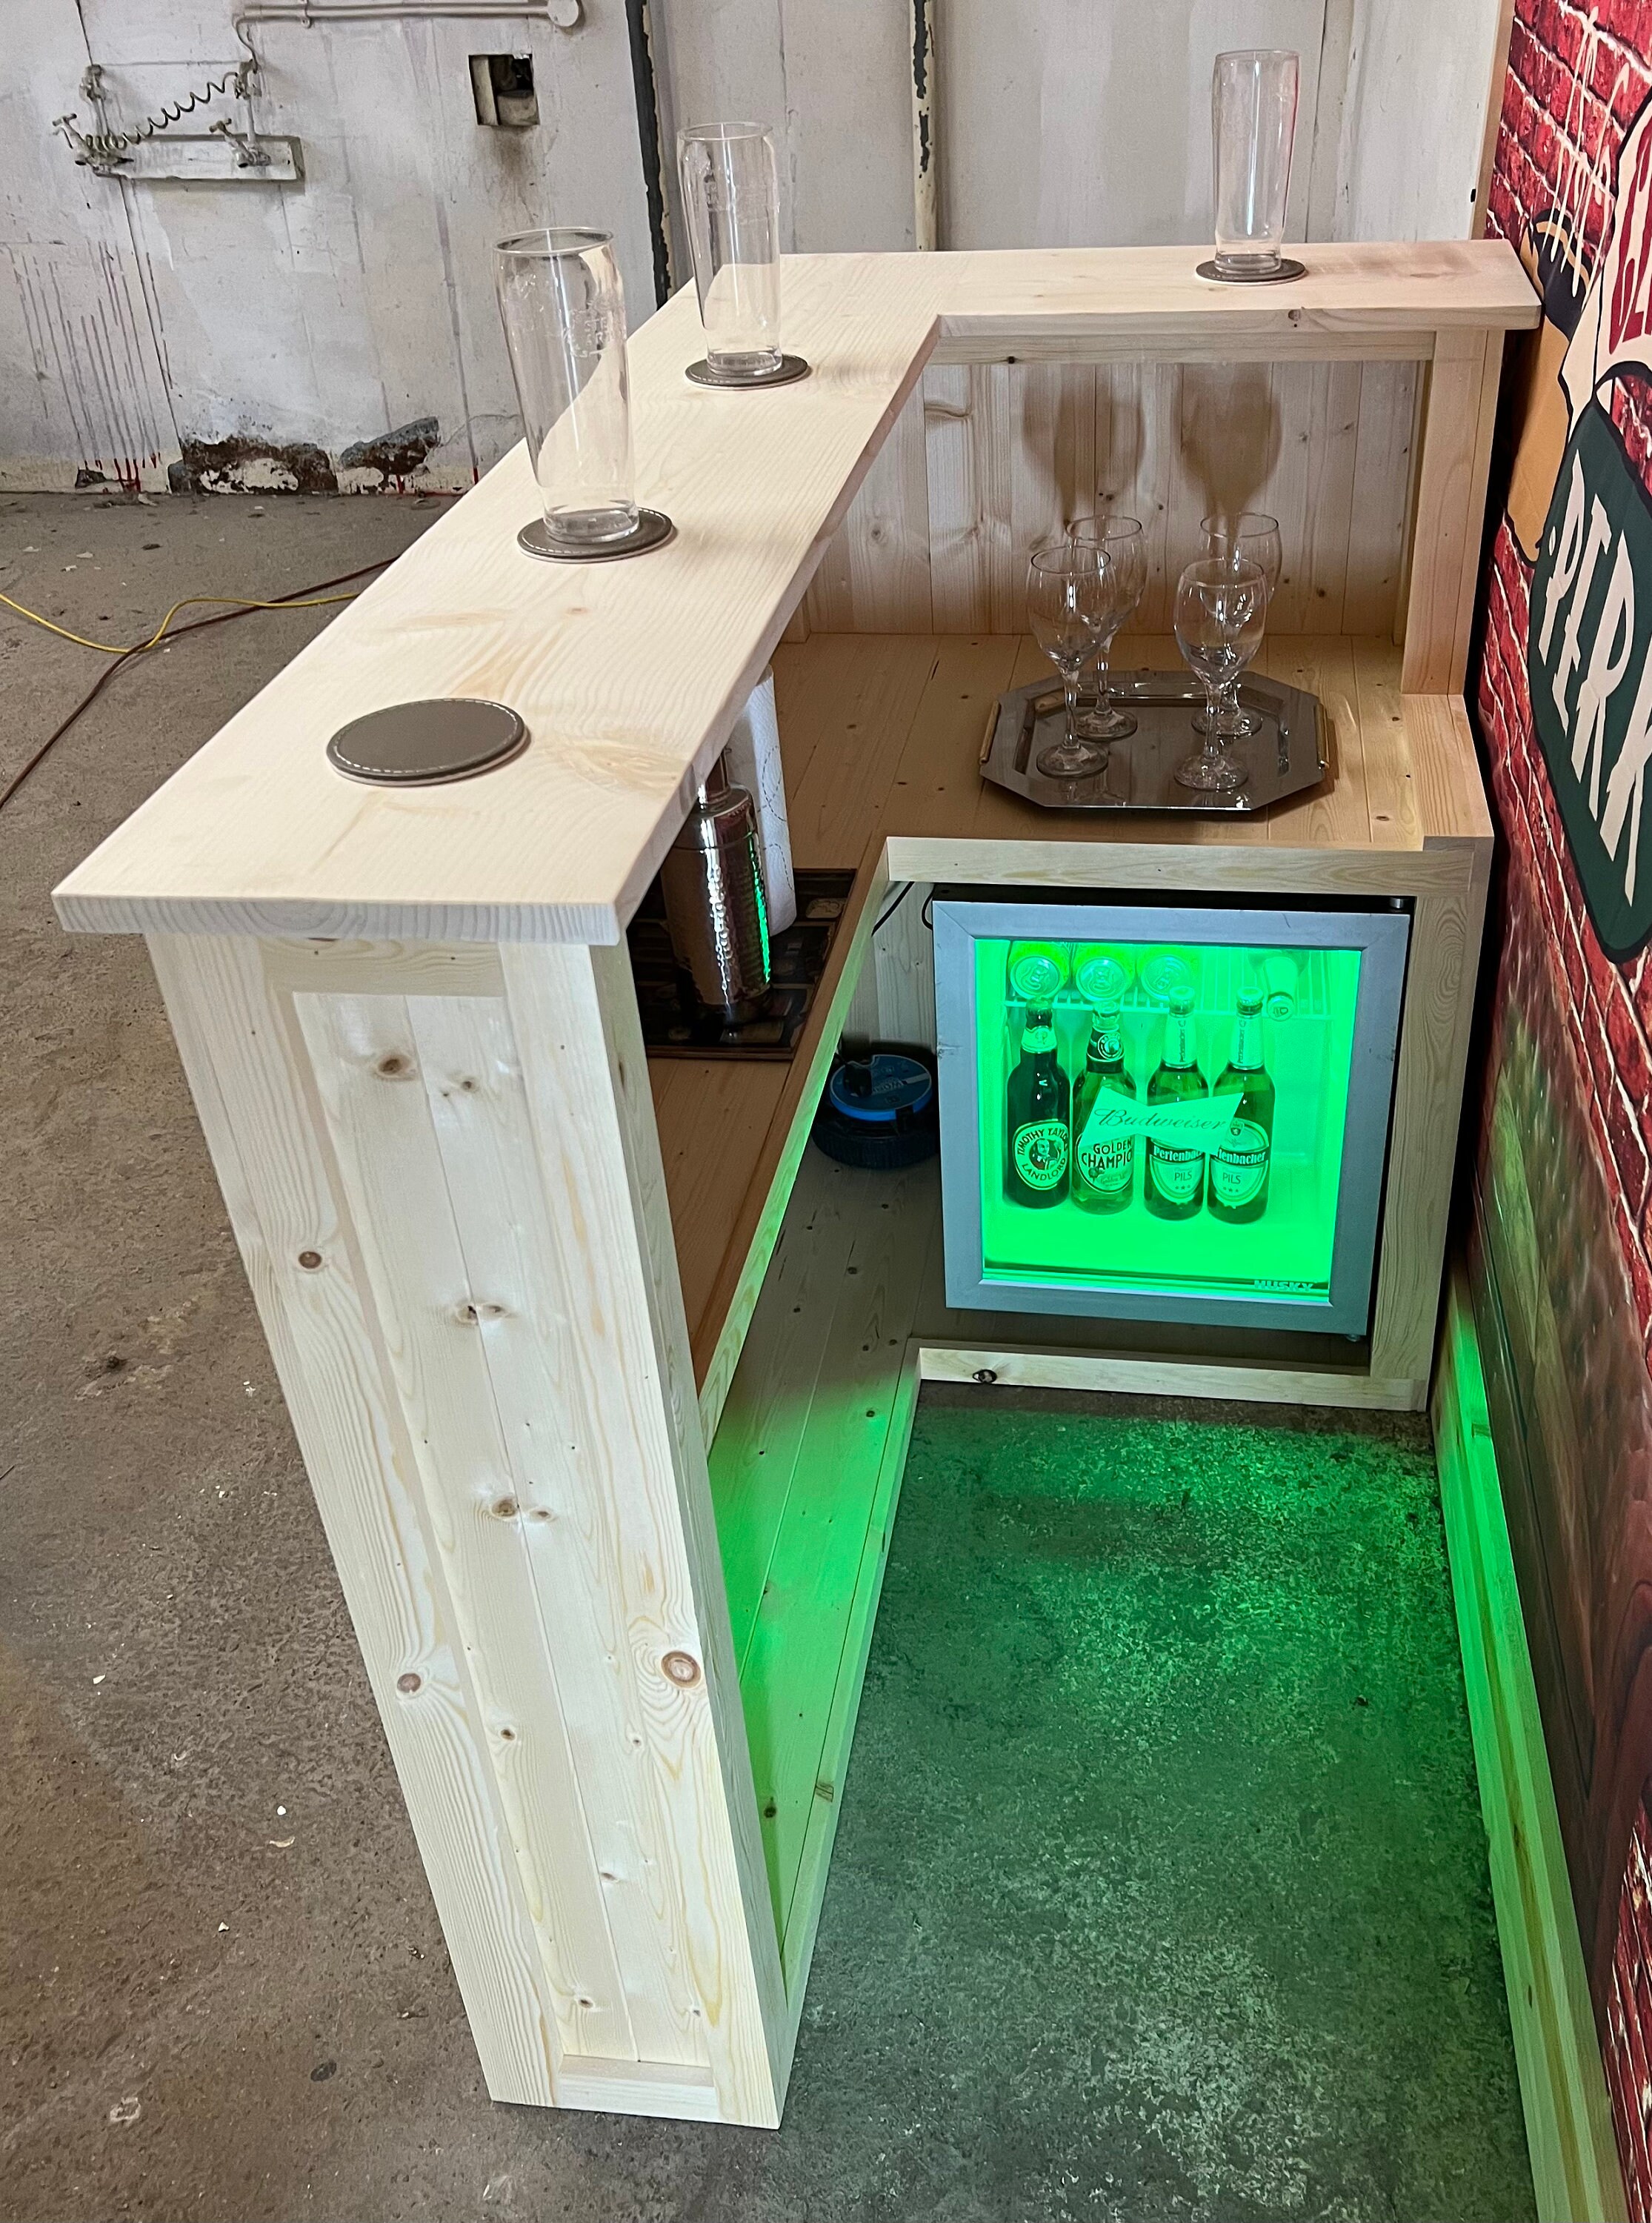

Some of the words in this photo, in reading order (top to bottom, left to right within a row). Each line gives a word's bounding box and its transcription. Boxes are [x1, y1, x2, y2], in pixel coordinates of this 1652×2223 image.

[1094, 1109, 1227, 1130] Budweiser
[1017, 1129, 1045, 1155] TIMOTHY
[1093, 1137, 1132, 1154] GOLDEN
[1082, 1148, 1133, 1170] CHAMPIO
[1153, 1145, 1202, 1161] Perlenbac
[1219, 1149, 1266, 1164] lenbacher
[1022, 1157, 1065, 1180] LANDLORD
[1174, 1171, 1192, 1181] PILS
[1223, 1172, 1242, 1184] PILS
[1254, 1280, 1313, 1292] HUSKY
